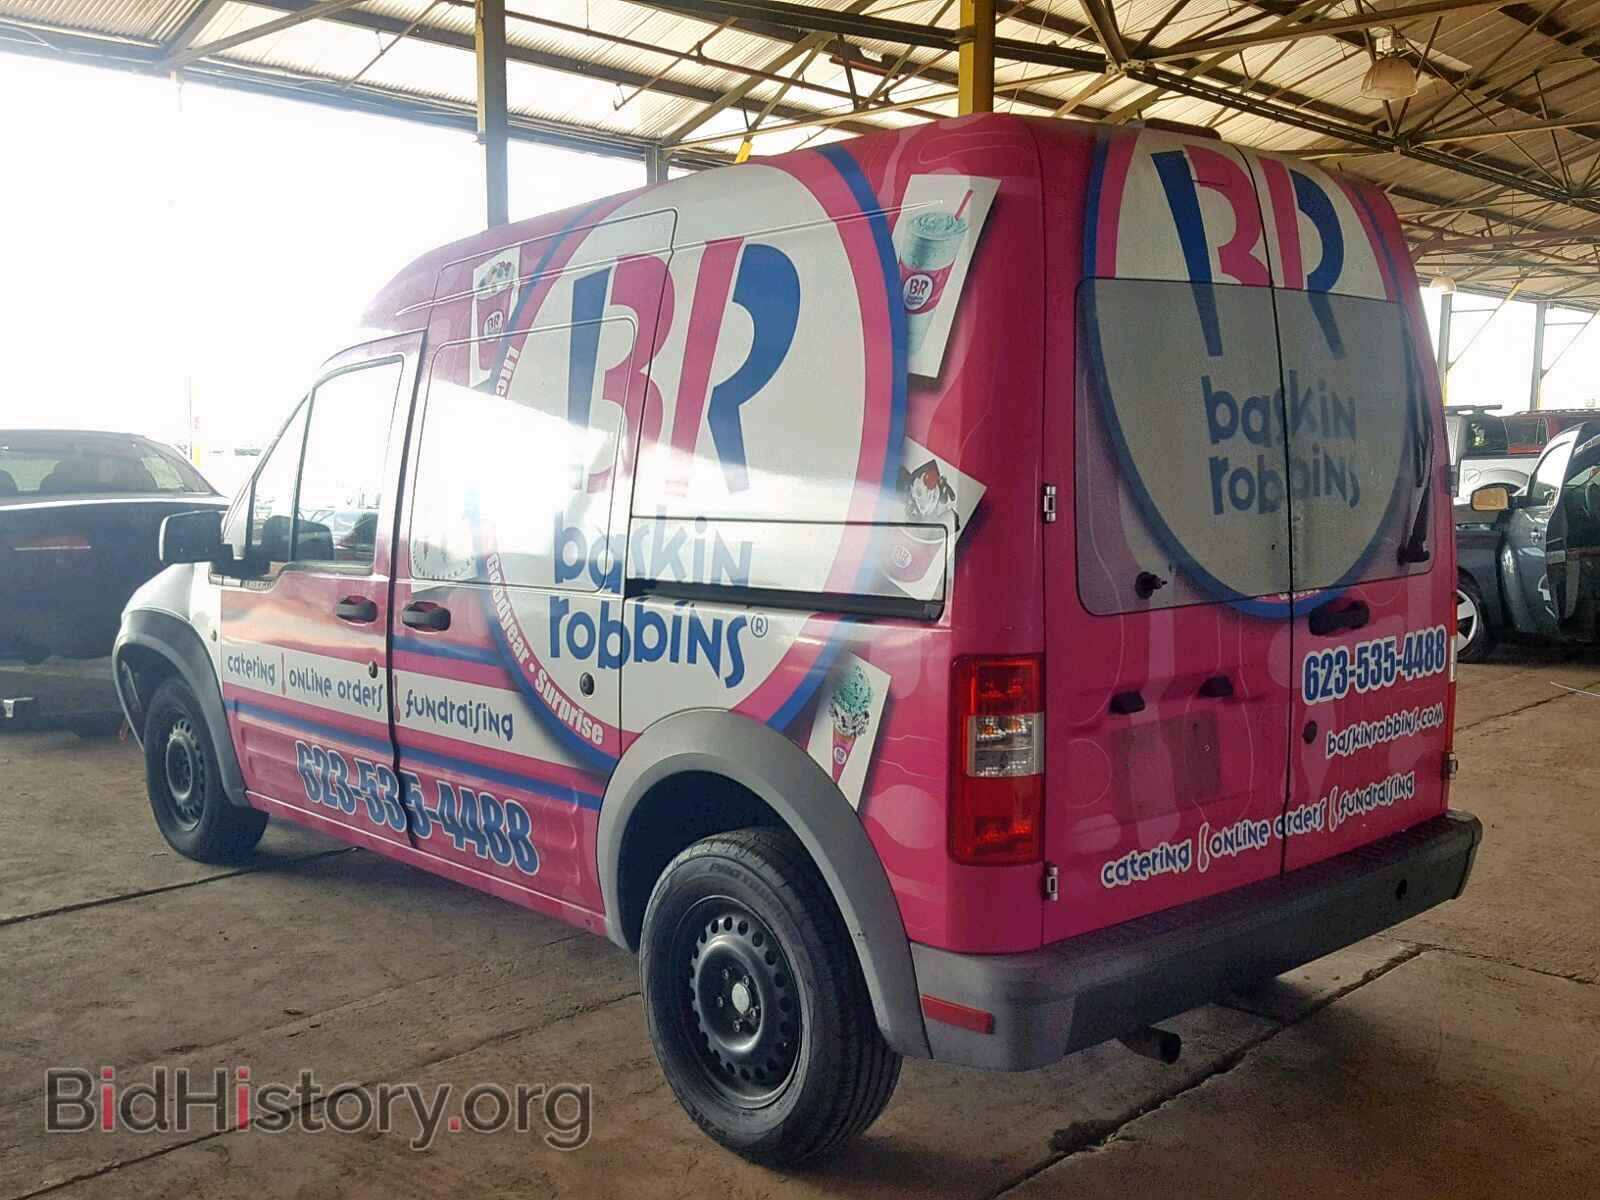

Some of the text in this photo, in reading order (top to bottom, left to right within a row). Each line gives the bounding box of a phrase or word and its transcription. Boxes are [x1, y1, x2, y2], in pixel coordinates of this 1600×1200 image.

[1151, 144, 1346, 360] BR
[567, 237, 800, 495] BR
[1201, 369, 1357, 447] baskin
[554, 504, 753, 594] baskin
[227, 653, 276, 687] catering
[337, 679, 384, 713] orders
[405, 688, 514, 743] fundraising
[535, 668, 605, 746] Surprise
[1304, 626, 1446, 705] 623-535-4488
[1326, 702, 1445, 759] baskinrobbins.com
[295, 740, 541, 877] 623-535-4488
[1101, 839, 1192, 887] catering
[1274, 796, 1328, 839] orders
[1337, 771, 1415, 824] fundraising
